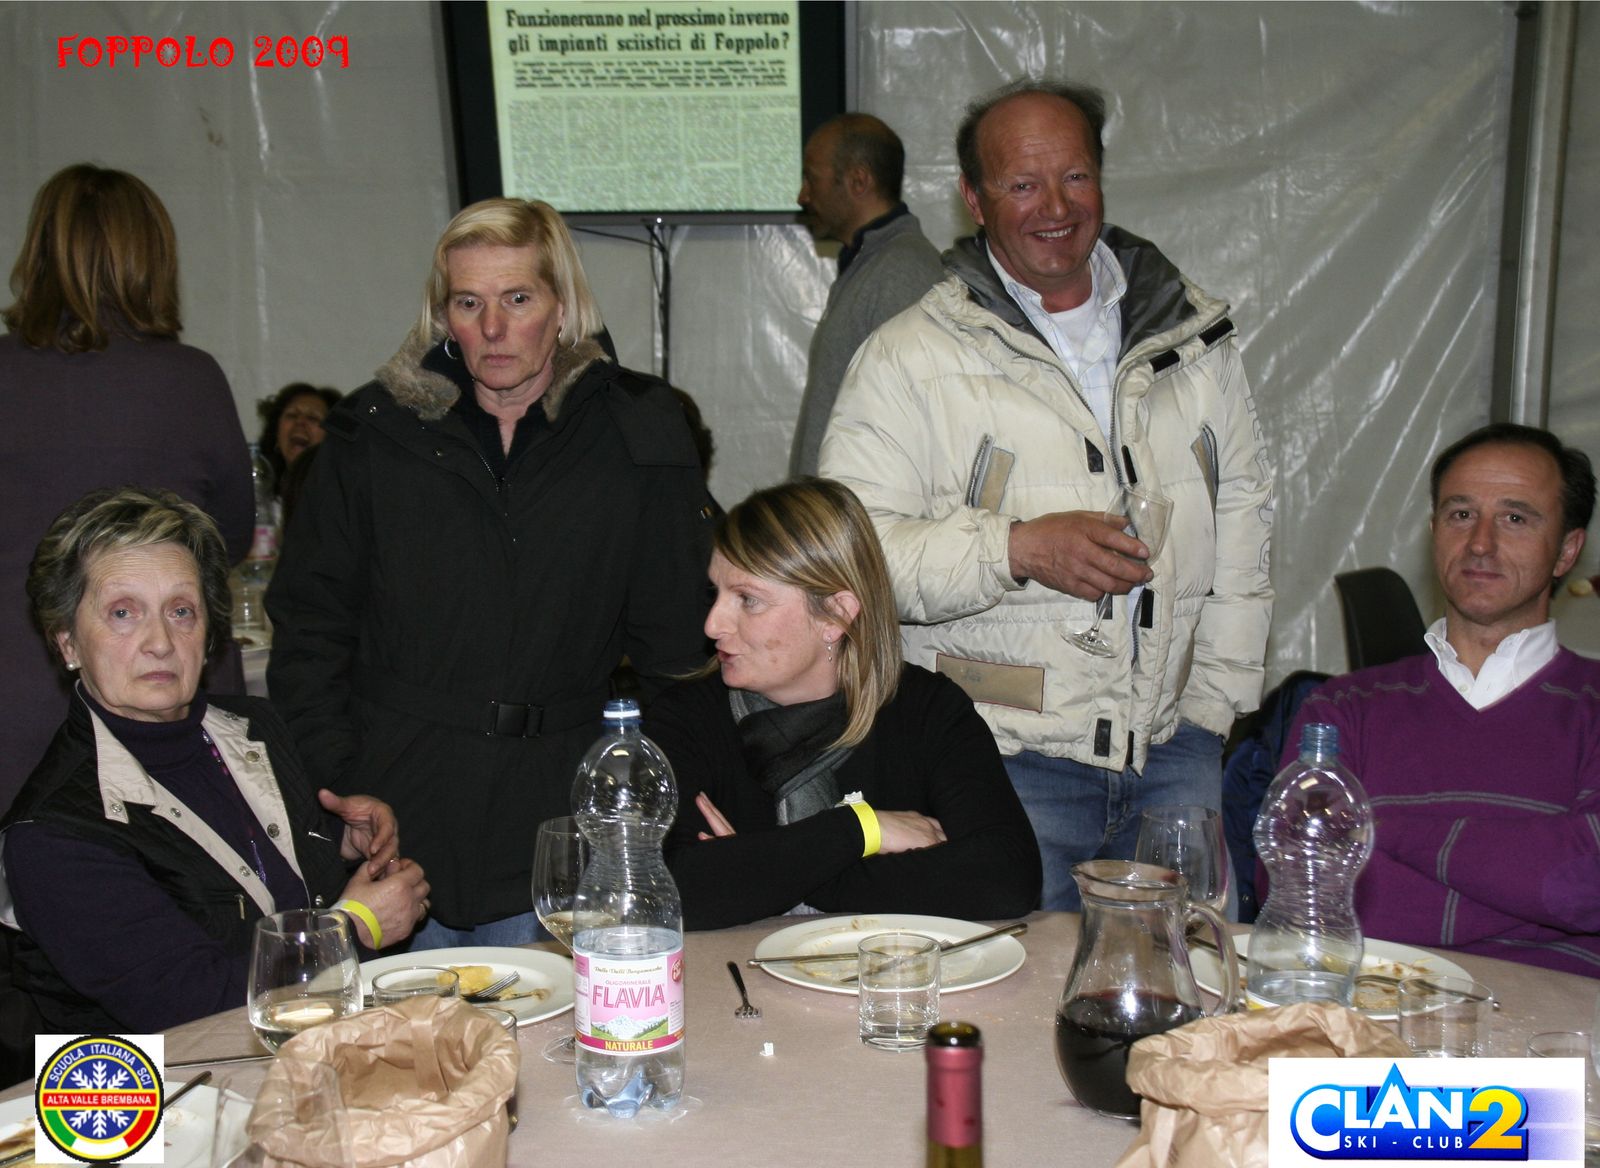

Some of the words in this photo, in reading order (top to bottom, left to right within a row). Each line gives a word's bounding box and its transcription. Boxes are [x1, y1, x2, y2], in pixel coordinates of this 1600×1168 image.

[506, 8, 625, 28] Funzioneranno
[628, 8, 652, 27] nel
[655, 7, 726, 31] prossimo
[729, 7, 790, 26] inverno
[508, 33, 530, 55] gli
[538, 33, 608, 55] impianti
[617, 33, 681, 51] sciistici
[690, 33, 706, 51] di
[714, 31, 790, 54] Foppolo?
[592, 984, 666, 1009] FLAVIA
[605, 1040, 654, 1051] NATURALE
